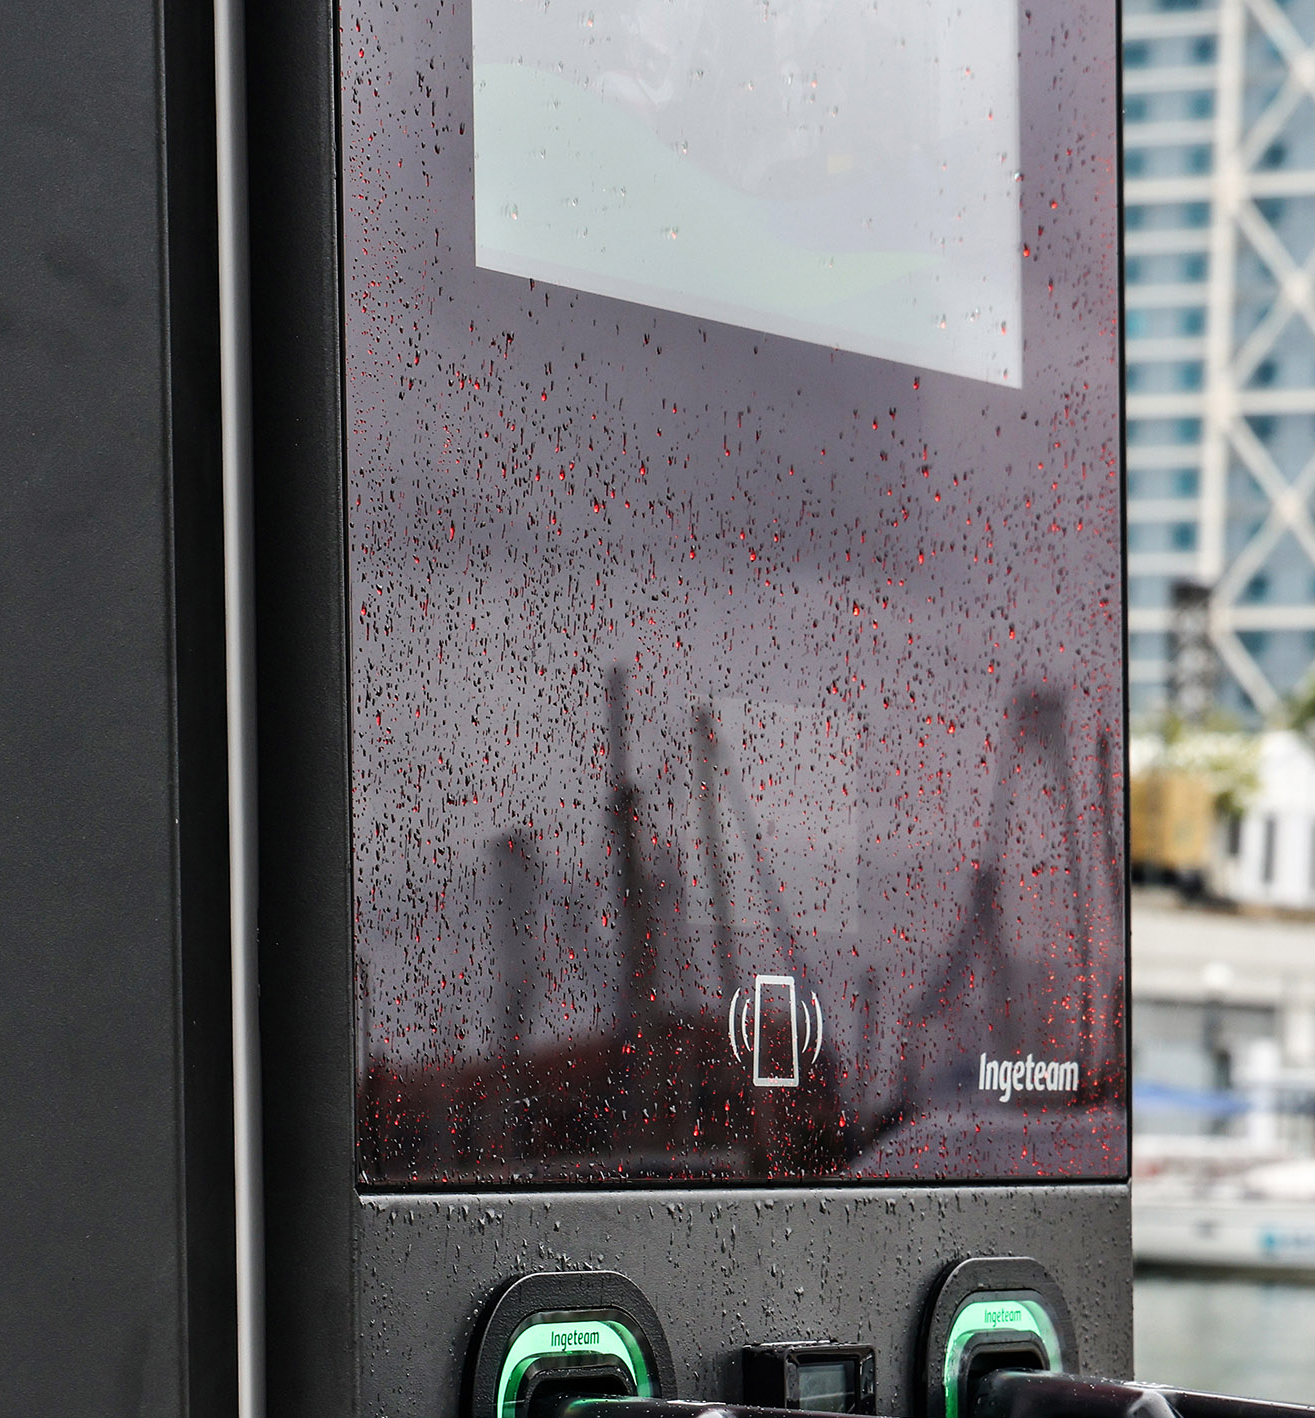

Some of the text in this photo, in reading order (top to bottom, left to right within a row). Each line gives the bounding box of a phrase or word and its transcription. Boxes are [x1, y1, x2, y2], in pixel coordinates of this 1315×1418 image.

[978, 1052, 1080, 1103] Ingeteam
[984, 1309, 1022, 1328] Ingeteam
[550, 1330, 600, 1352] Ingeteam
